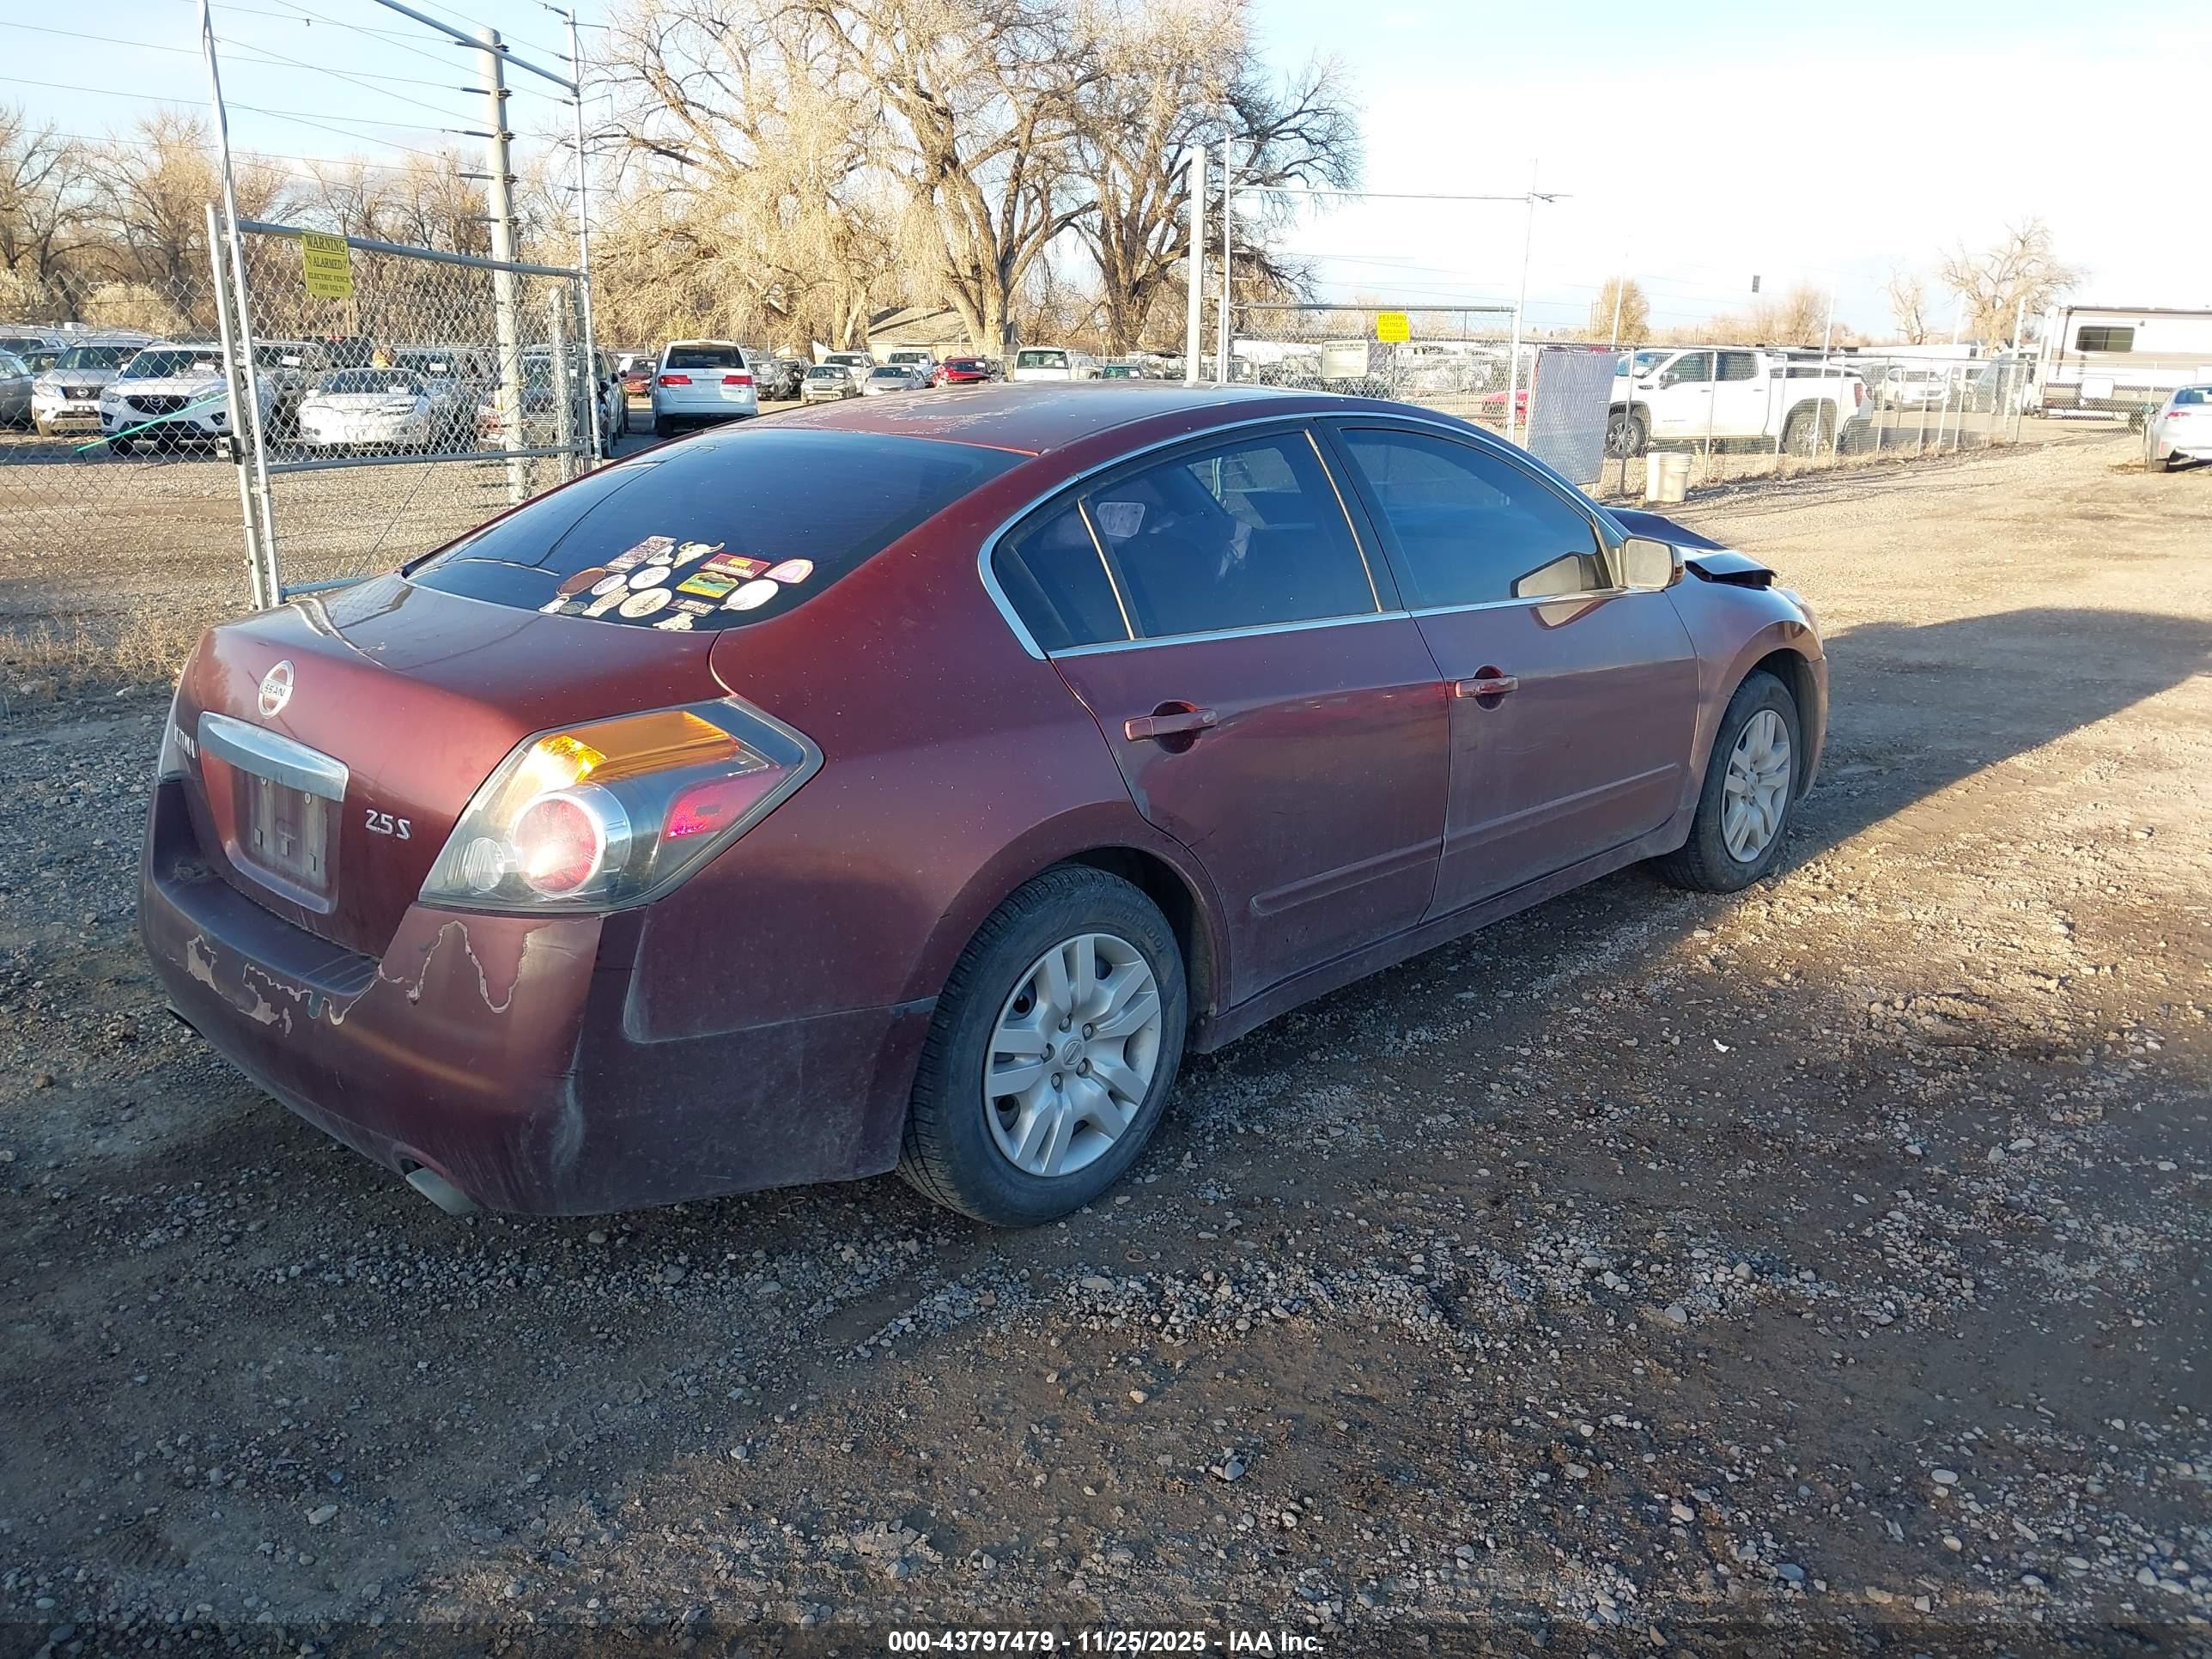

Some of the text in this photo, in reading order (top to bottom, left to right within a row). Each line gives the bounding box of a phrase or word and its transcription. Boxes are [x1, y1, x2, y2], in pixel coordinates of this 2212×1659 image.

[306, 235, 345, 252] WARNING
[313, 256, 343, 270] ALARMED
[333, 275, 349, 283] FENCE
[396, 817, 411, 840] S
